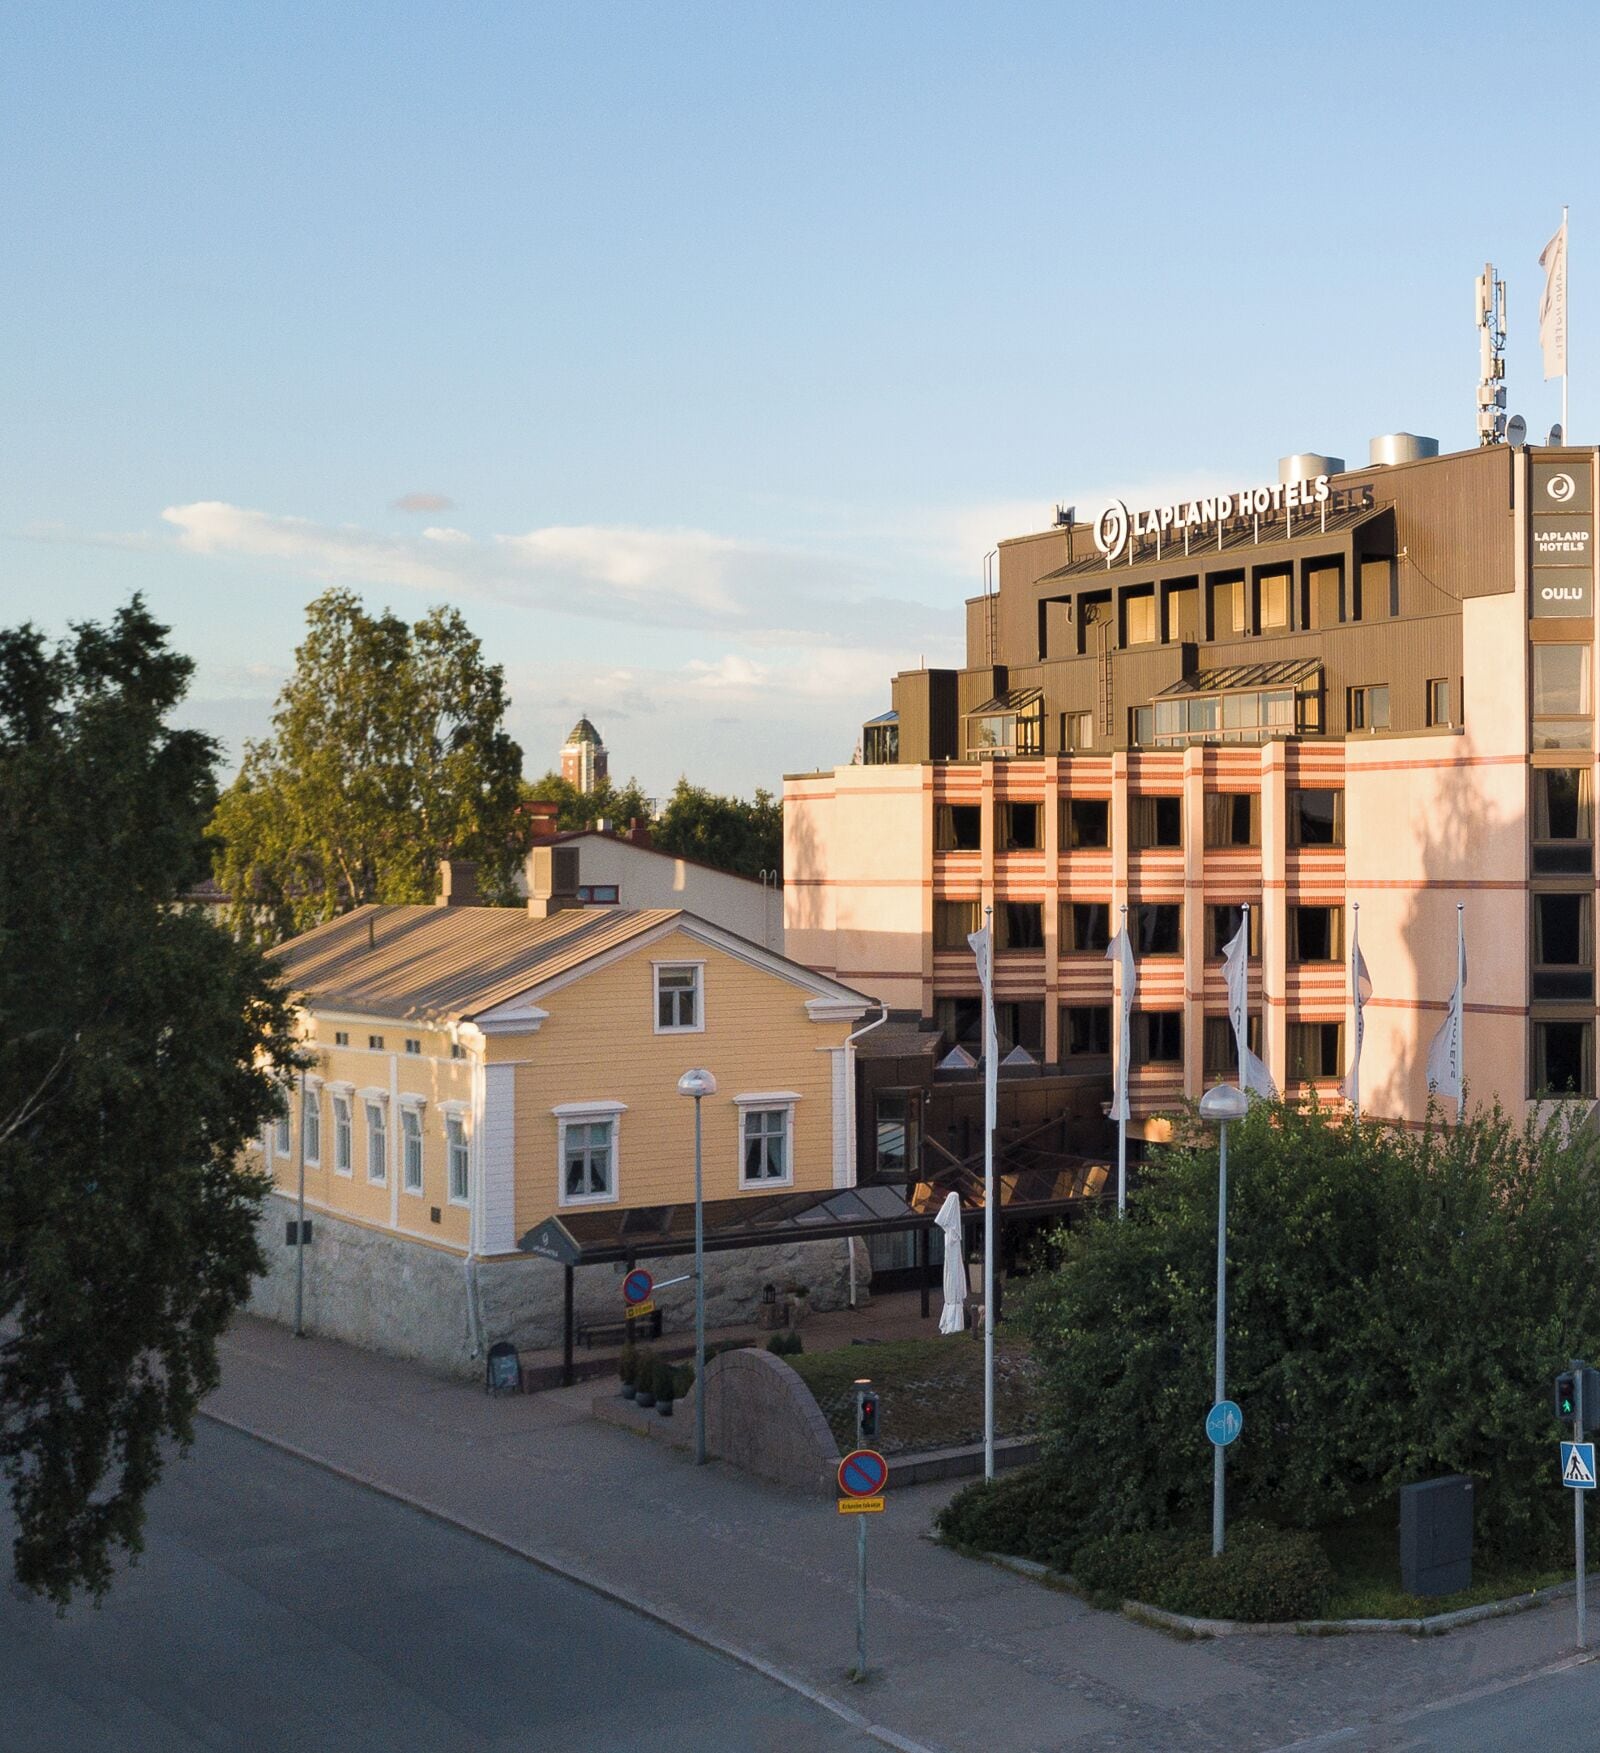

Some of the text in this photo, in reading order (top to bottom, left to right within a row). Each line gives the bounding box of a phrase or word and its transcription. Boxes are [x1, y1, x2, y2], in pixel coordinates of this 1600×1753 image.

[1133, 474, 1329, 536] LAPLAND HOTELS
[1534, 531, 1589, 542] LAPLAND
[1539, 542, 1585, 552] HOTELS
[1541, 587, 1583, 600] OULU
